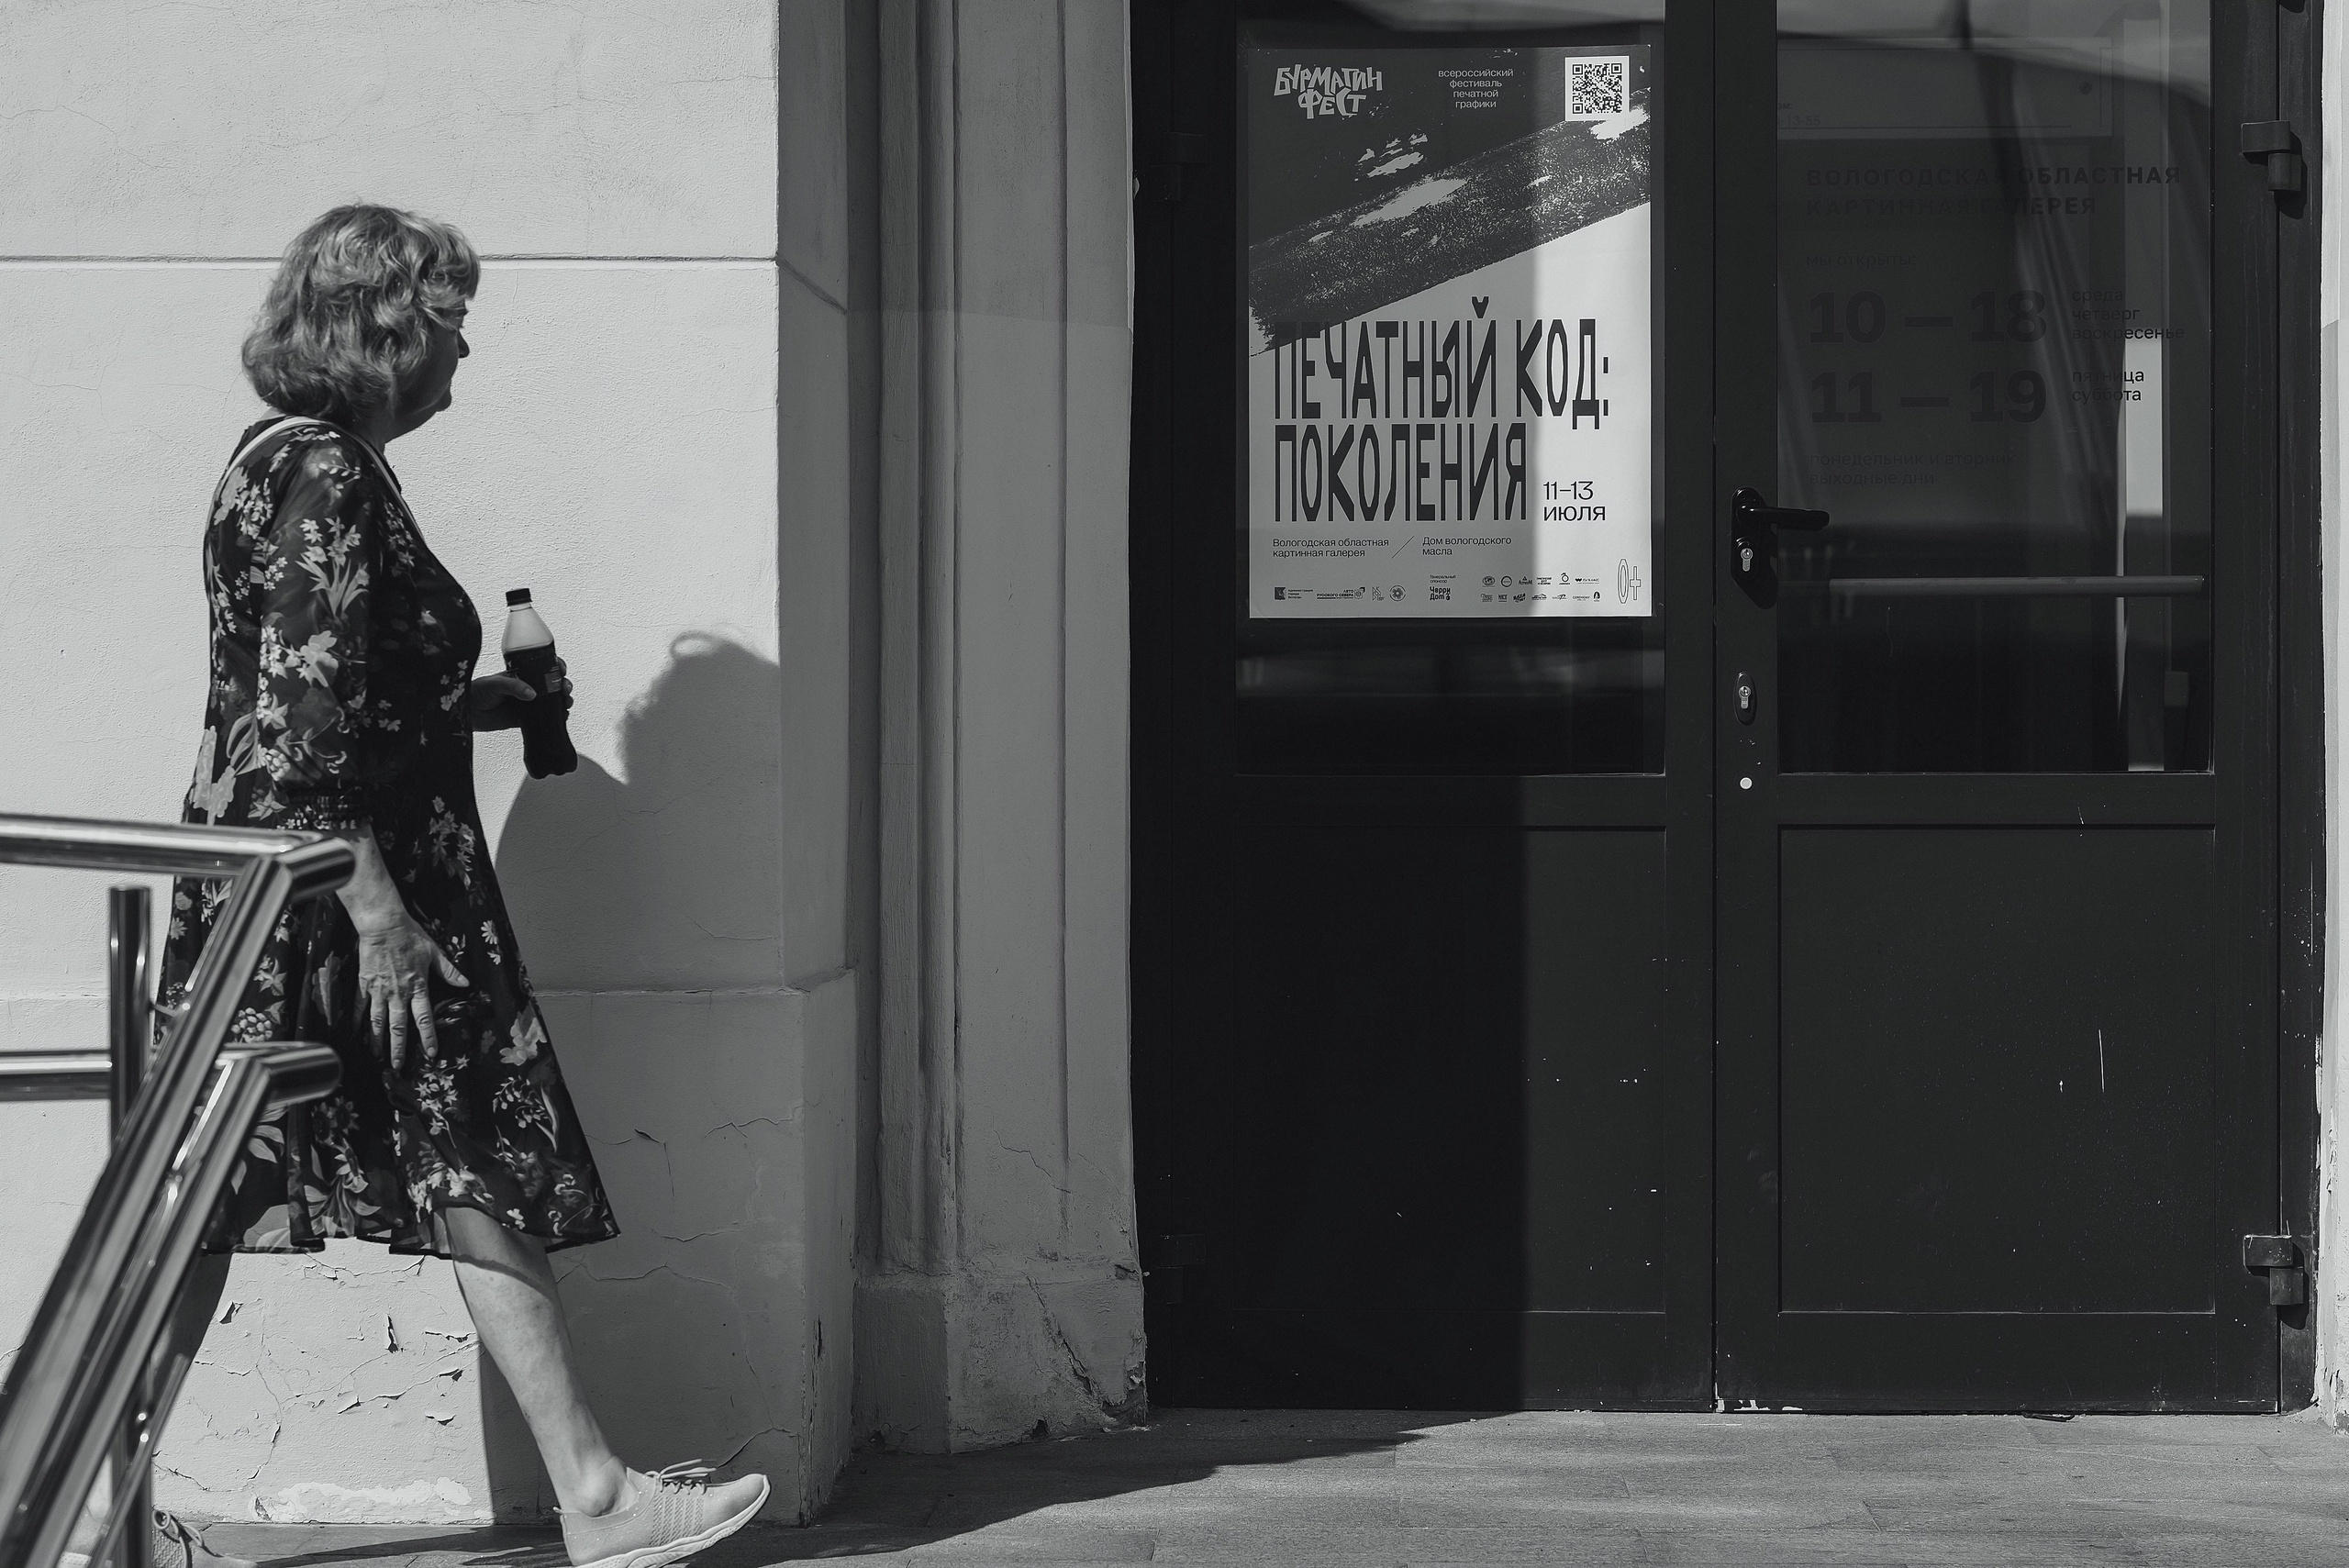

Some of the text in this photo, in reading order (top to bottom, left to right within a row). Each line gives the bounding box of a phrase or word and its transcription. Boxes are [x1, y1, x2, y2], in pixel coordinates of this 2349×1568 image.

[1438, 69, 1514, 79] всероссийский
[1449, 79, 1503, 89] фестиваль
[1453, 89, 1499, 98] печатной
[1297, 87, 1367, 119] ФЕСТ
[1455, 99, 1497, 109] графики
[1807, 166, 2180, 188] ВОЛОГОДСКАЯ ОБЛАСТНАЯ
[1807, 195, 2097, 216] КАРТИННАЯ ГАЛЕРЕЯ
[1806, 255, 1917, 269] мы открыты:
[2072, 291, 2123, 304] среда
[1809, 290, 1887, 343] 10
[1971, 290, 2047, 343] 18
[2072, 309, 2141, 323] четверг
[2073, 328, 2186, 342] воскресенье
[1275, 295, 1609, 430] ПЕЧАТНЫЙ КОД:
[2072, 371, 2144, 384] пятница
[1811, 372, 1882, 423] 11
[1970, 370, 2047, 423] 19
[2072, 388, 2142, 405] суббота
[1809, 453, 2016, 468] понедельник и вторник
[1275, 423, 1527, 522] ПОКОЛЕНИЯ
[1809, 473, 1934, 486] выходные дни
[1273, 538, 1389, 549] Вологодская областная
[1422, 537, 1512, 547] Дом вологодского
[1273, 549, 1365, 559] картинная галерея
[1422, 548, 1453, 556] масла
[1617, 558, 1642, 604] 0+
[1430, 586, 1451, 595] Черри
[1430, 593, 1445, 601] Дом
